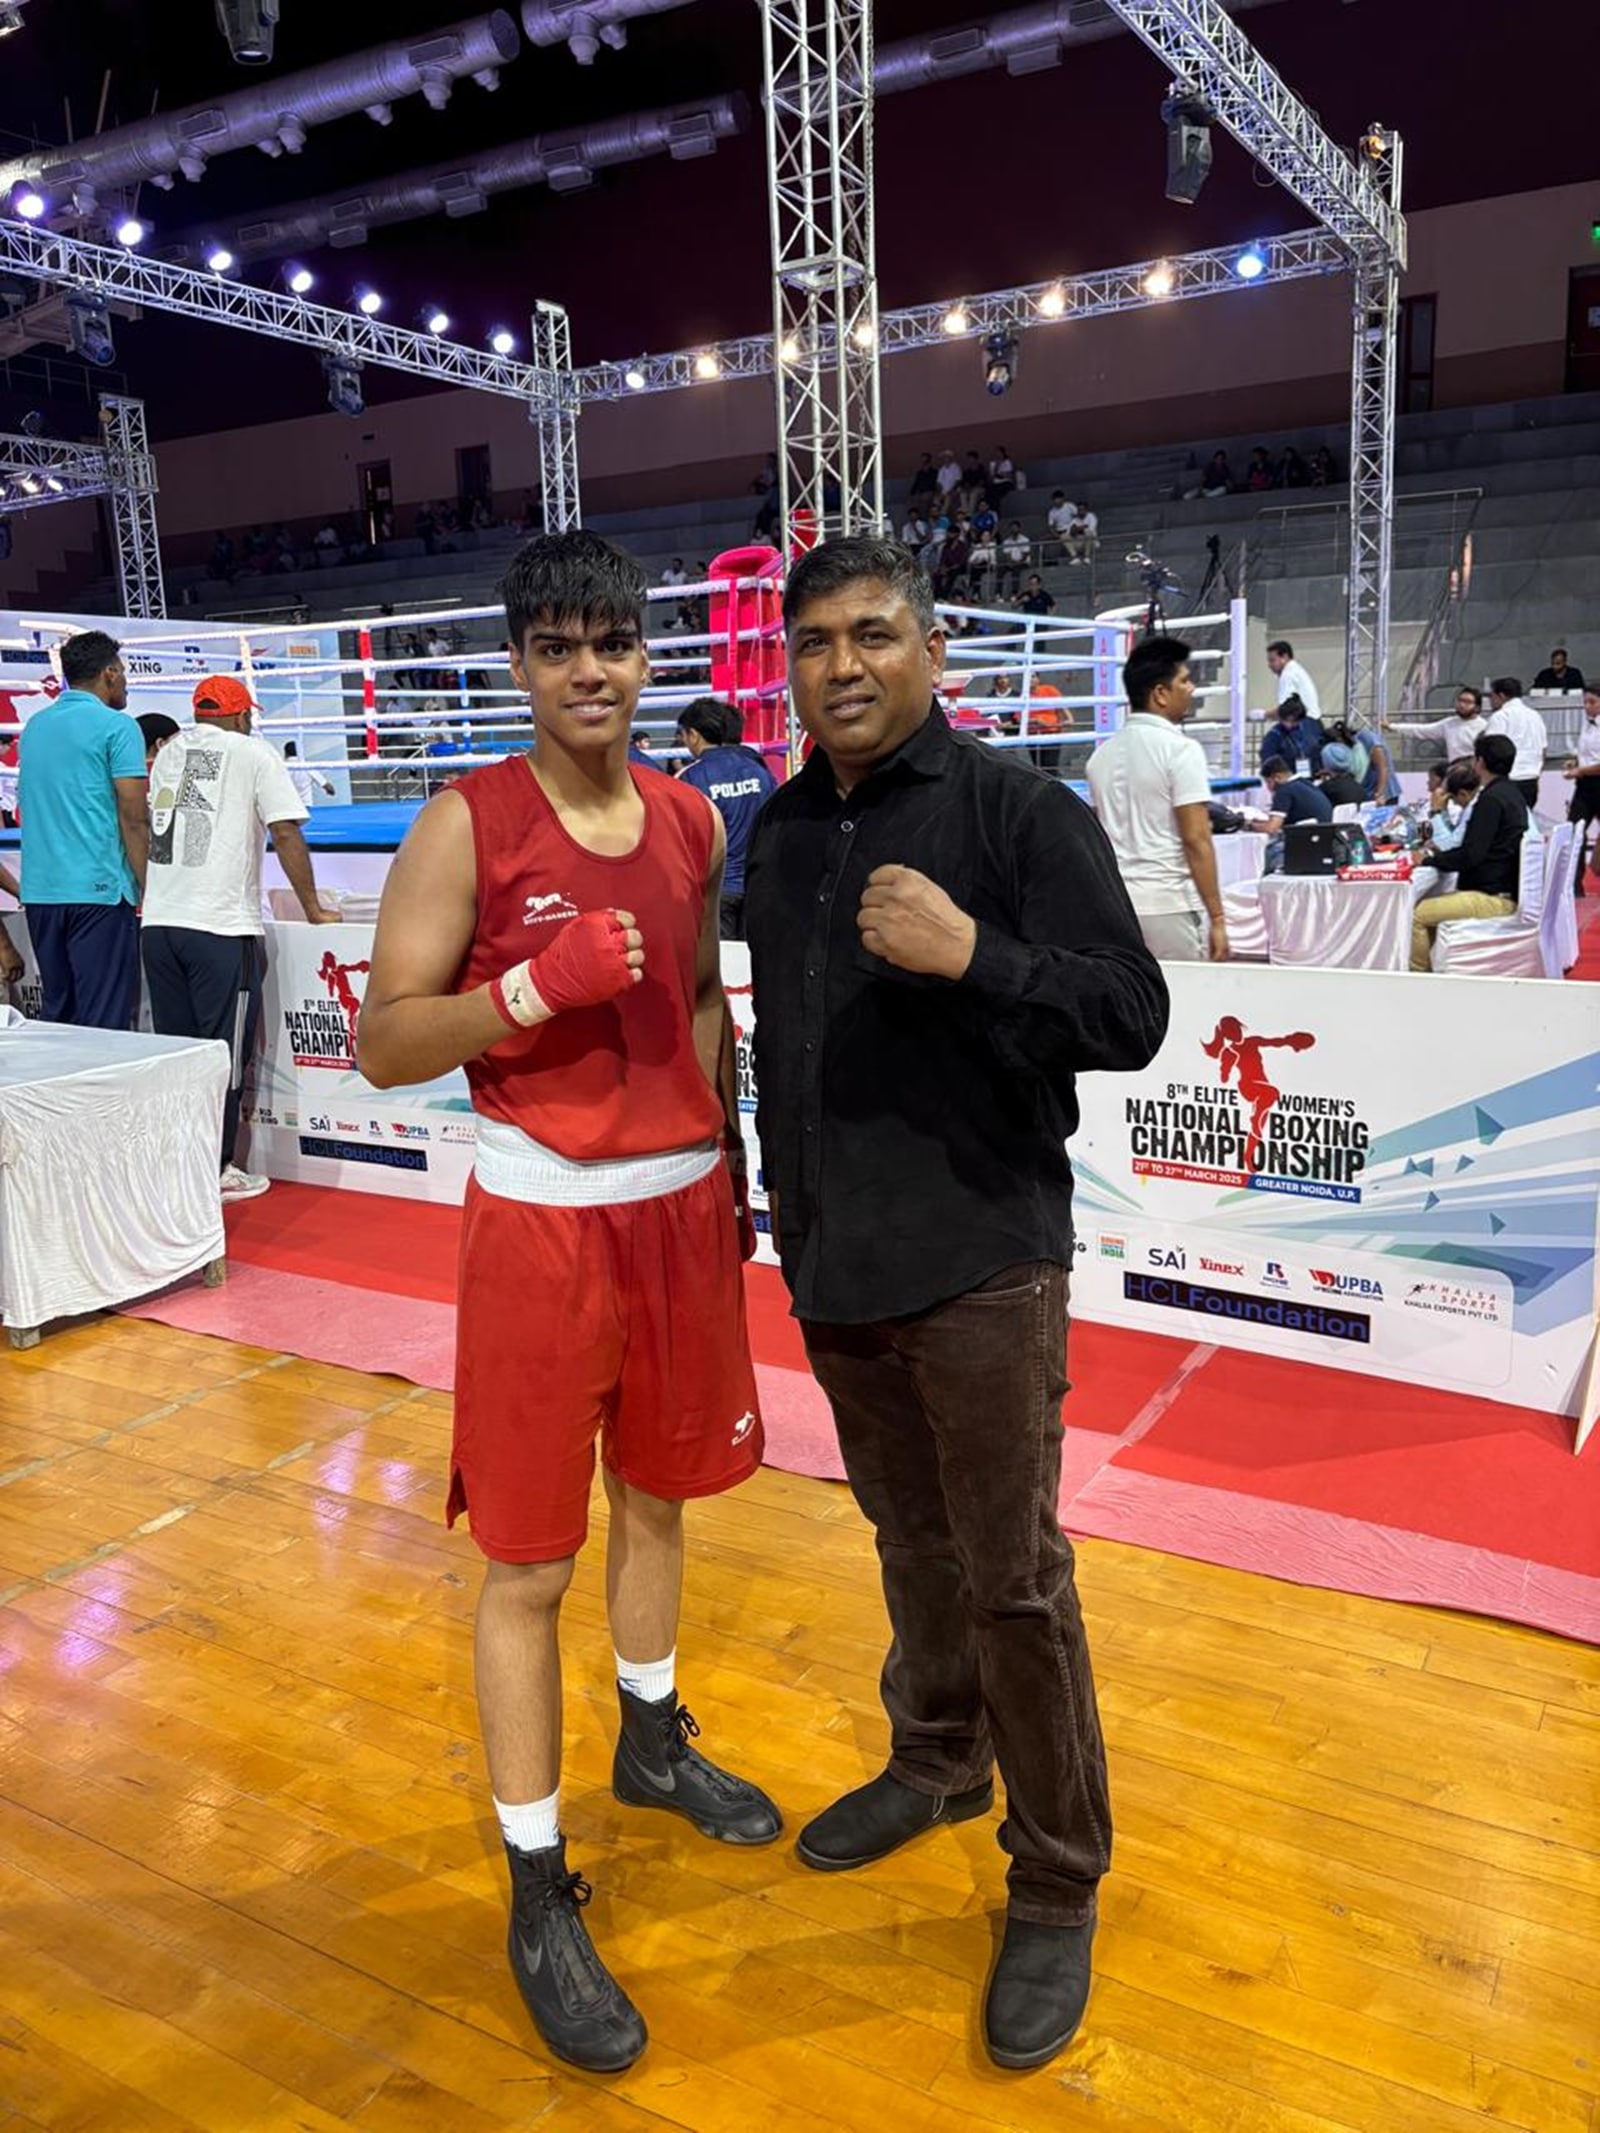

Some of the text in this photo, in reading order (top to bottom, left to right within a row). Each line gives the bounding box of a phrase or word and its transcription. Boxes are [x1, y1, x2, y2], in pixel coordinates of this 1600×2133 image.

[709, 778, 761, 800] POLICE
[317, 1000, 341, 1013] ELITE
[284, 1011, 349, 1033] NATIONAL
[1166, 1083, 1239, 1106] 8TH ELITE
[1125, 1098, 1248, 1136] NATIONAL
[1277, 1094, 1356, 1118] WOMEN'S
[1269, 1112, 1369, 1150] BOXING
[1130, 1126, 1366, 1184] CHAMPIONSHIP
[1151, 1163, 1164, 1174] TO
[1184, 1169, 1217, 1181] MARCH
[1219, 1174, 1242, 1185] 2025
[1255, 1178, 1299, 1194] GREATER
[1338, 1189, 1357, 1200] U.P.
[1148, 1247, 1186, 1271] SAI
[1335, 1274, 1384, 1296] UPBA
[1430, 1284, 1497, 1301] KHALSA
[1126, 1274, 1368, 1340] HCLFoundation
[1434, 1303, 1466, 1316] EXPORTS
[1468, 1308, 1482, 1319] PVT
[1485, 1311, 1499, 1322] LTD
[1442, 1295, 1496, 1311] SPORTS
